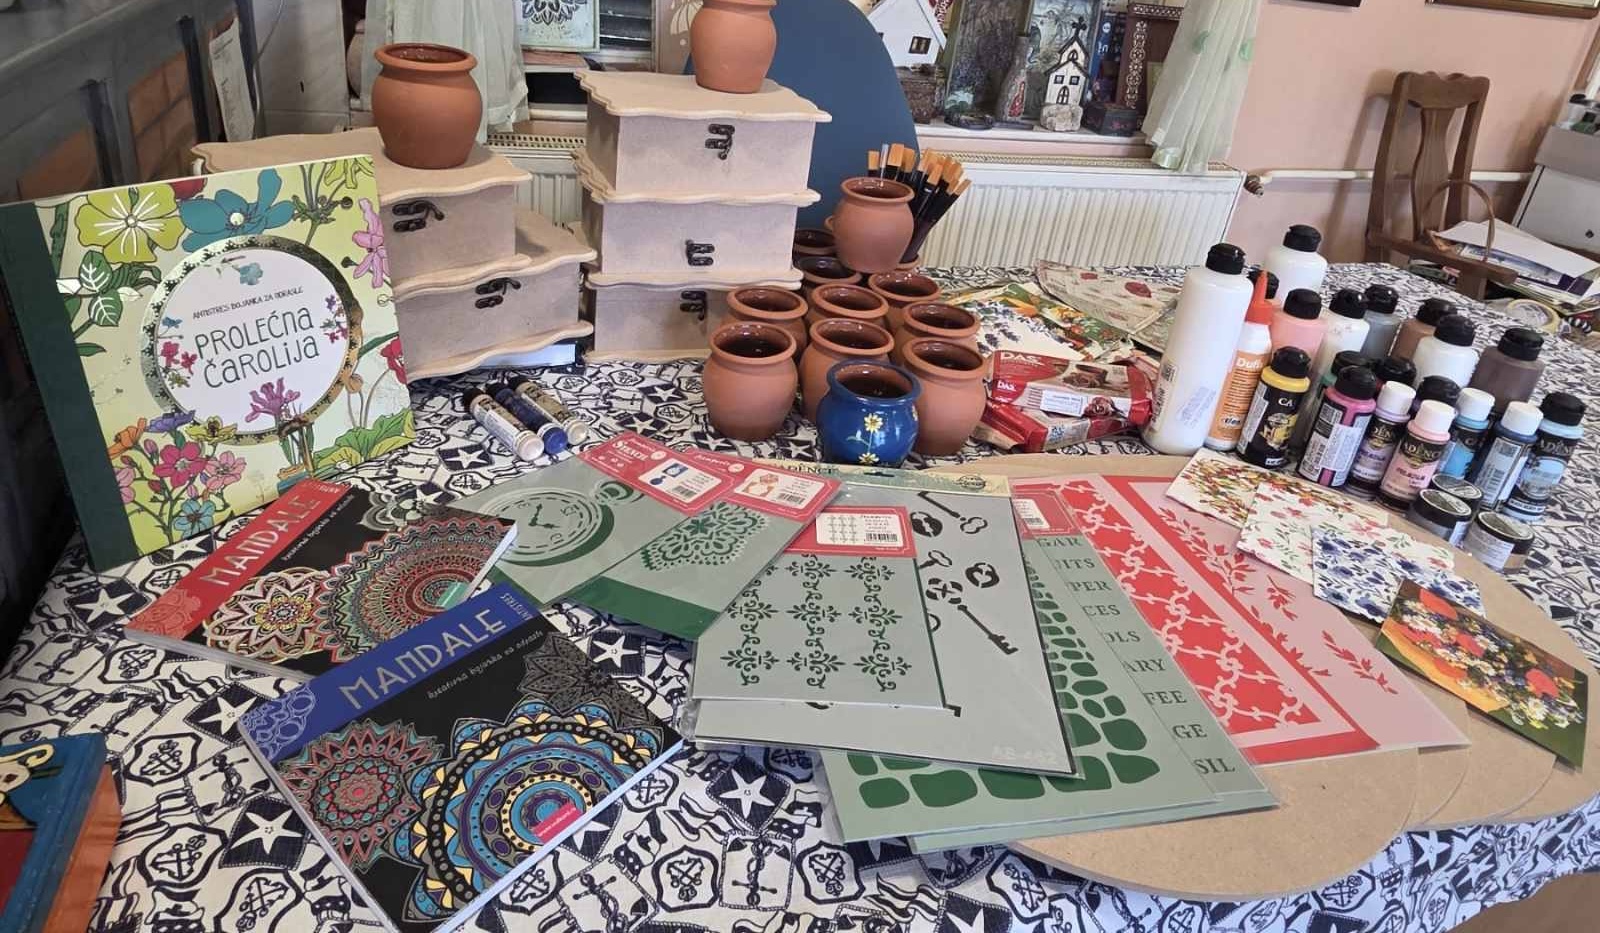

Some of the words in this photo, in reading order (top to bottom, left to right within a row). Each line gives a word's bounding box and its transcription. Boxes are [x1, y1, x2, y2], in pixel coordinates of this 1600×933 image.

[200, 494, 321, 586] MANDALE
[1082, 604, 1121, 617] CES
[338, 609, 507, 710] MANDALE
[1142, 690, 1188, 705] FEE
[1172, 723, 1208, 739] GE
[1193, 758, 1236, 775] SIL
